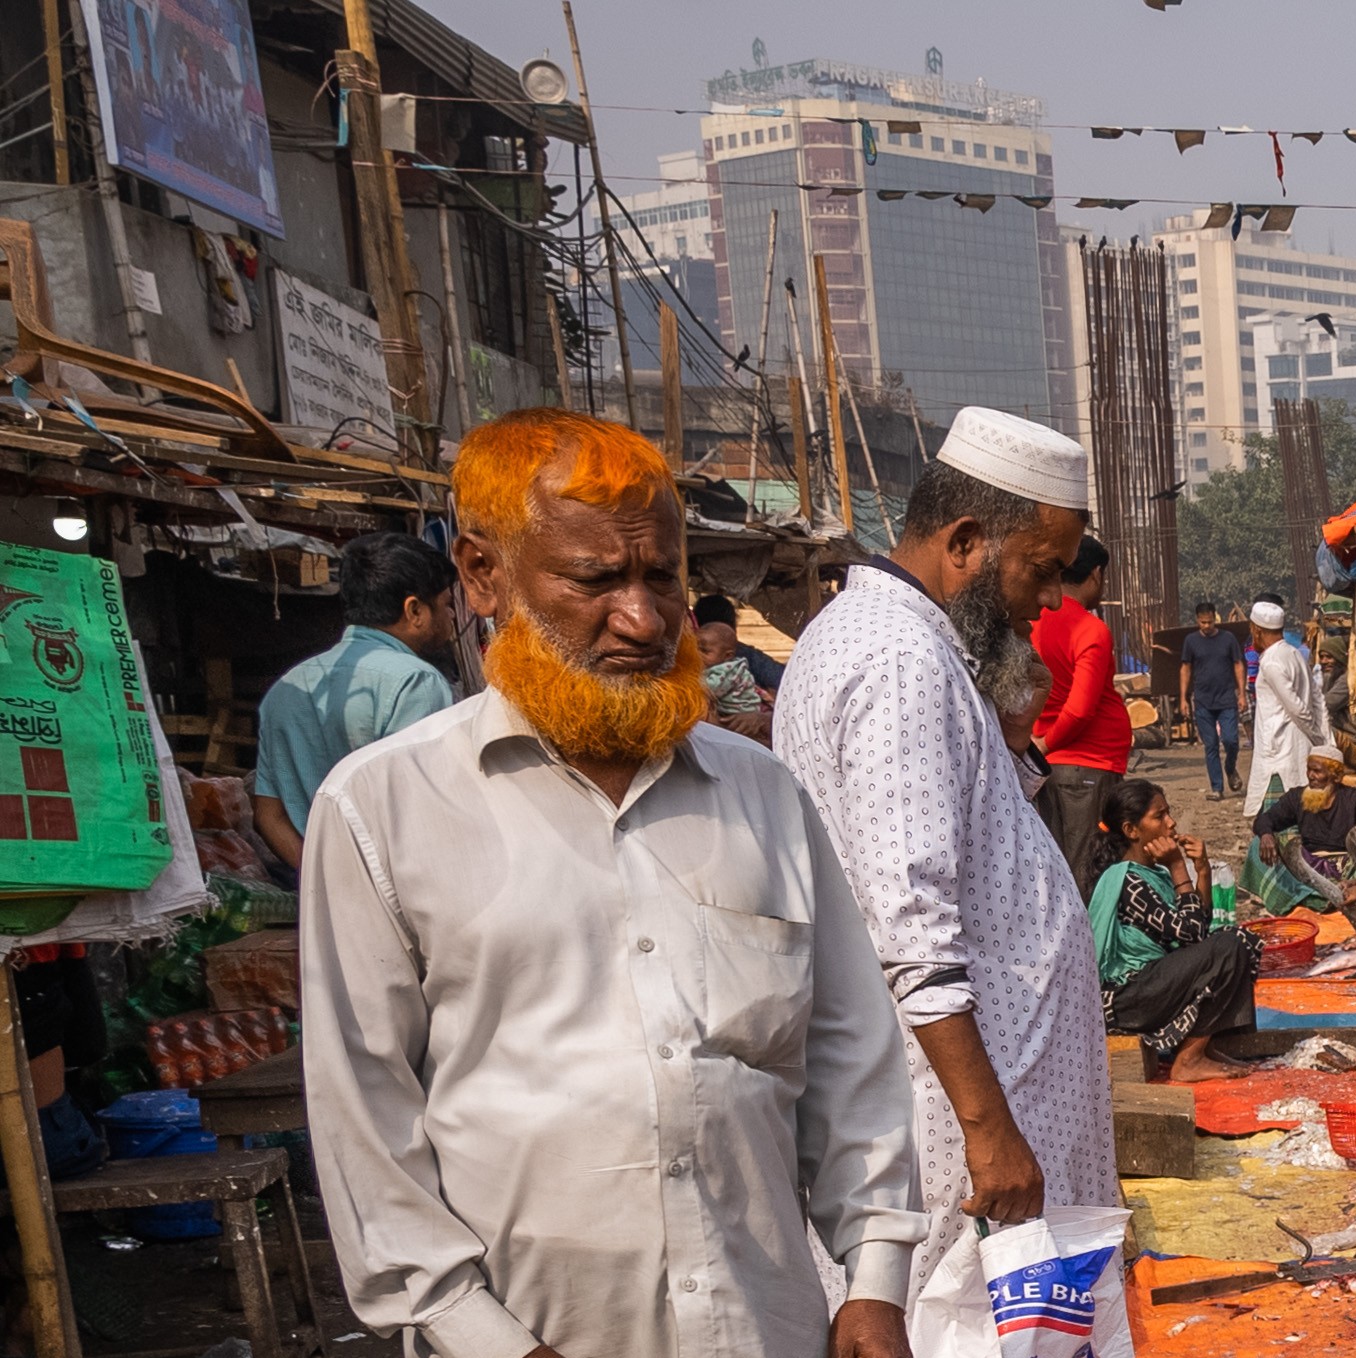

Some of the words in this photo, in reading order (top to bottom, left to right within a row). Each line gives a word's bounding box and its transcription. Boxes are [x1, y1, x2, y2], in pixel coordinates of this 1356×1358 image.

[284, 284, 308, 323] এই
[309, 301, 344, 341] জমির
[110, 627, 140, 691] PREMIER
